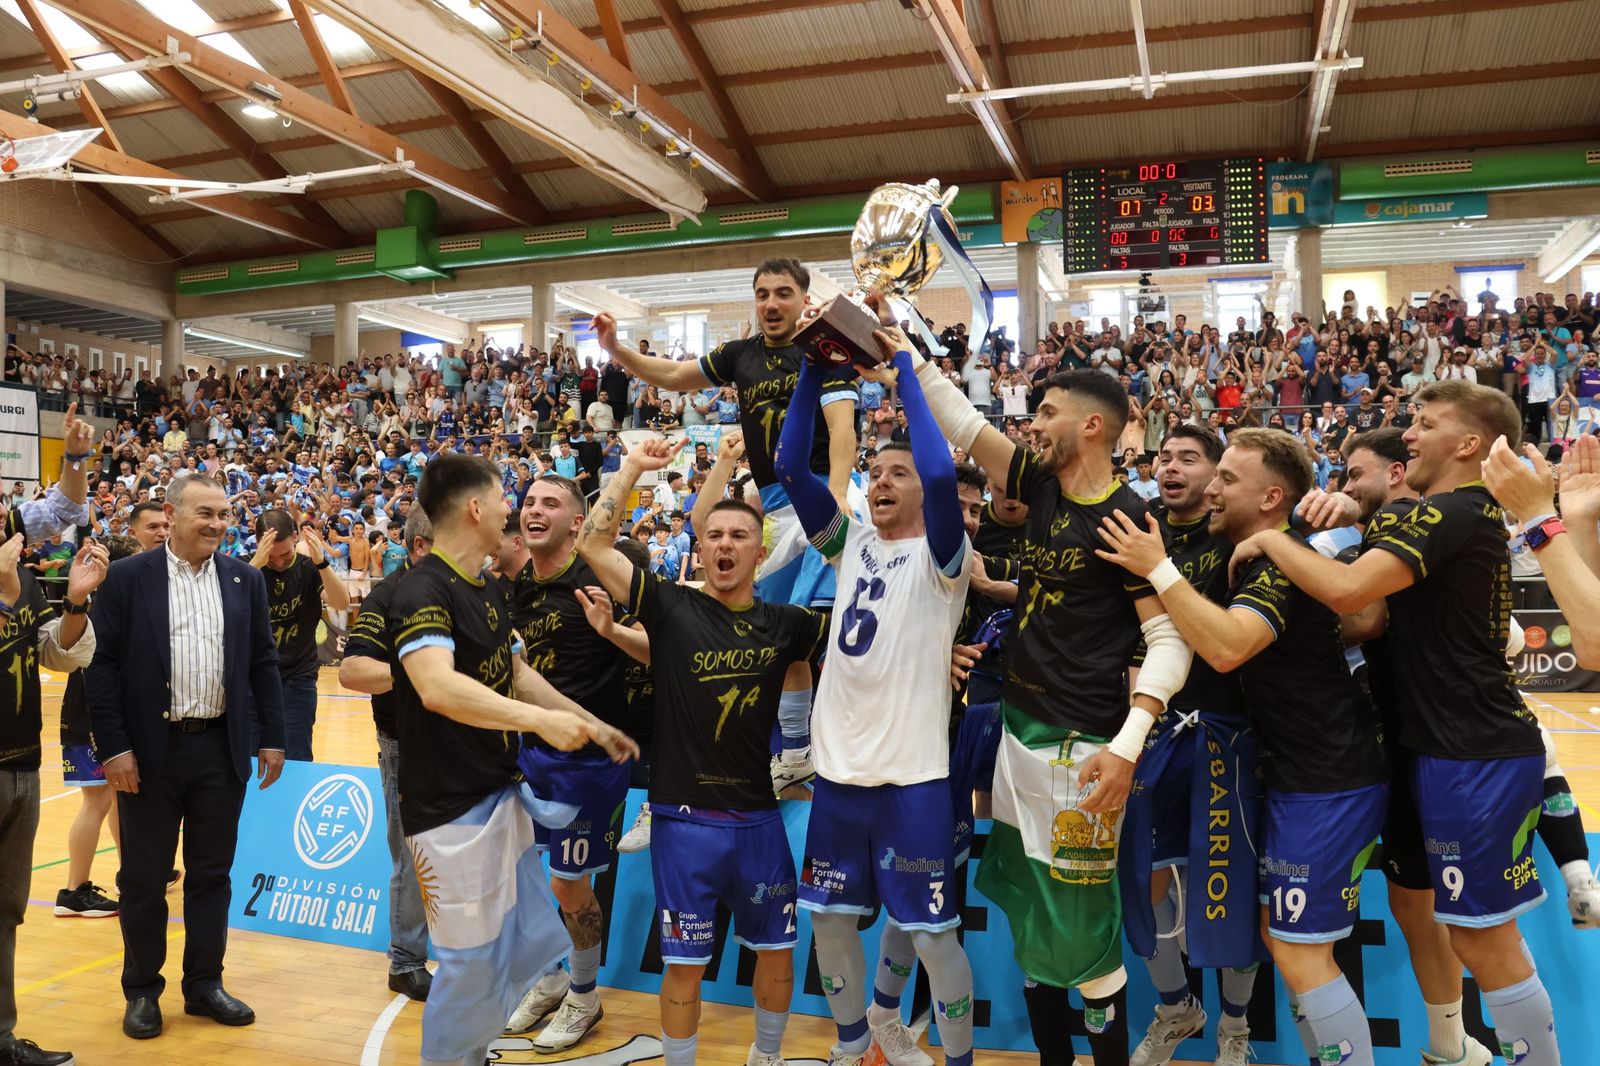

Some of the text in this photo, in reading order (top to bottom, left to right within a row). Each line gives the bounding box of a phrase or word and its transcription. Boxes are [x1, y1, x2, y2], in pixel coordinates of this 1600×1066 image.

[1117, 187, 1146, 196] LOCAL
[1183, 182, 1212, 191] VISITANTE
[1160, 193, 1168, 205] 2
[1193, 195, 1213, 211] 03
[1121, 200, 1141, 216] 07
[1384, 201, 1455, 218] cajamar
[1110, 222, 1135, 230] JUGADOR
[1167, 219, 1193, 227] JUGADOR
[1110, 232, 1128, 245] 00
[1110, 247, 1131, 255] FALTAS
[1179, 253, 1187, 266] 3
[838, 576, 887, 657] 6
[691, 646, 778, 674] SOMOS DE
[561, 838, 589, 866] 10
[812, 858, 830, 868] Grupo
[896, 857, 945, 873] Bioline
[1442, 866, 1465, 901] 9
[1514, 868, 1538, 890] EXPE
[277, 875, 381, 901] DIVISIÓN
[928, 881, 945, 915] 3
[1273, 886, 1307, 923] 19
[268, 888, 377, 935] FÚTBOL SALA
[679, 911, 698, 921] Grupo
[783, 902, 797, 934] 2
[682, 930, 690, 941] &
